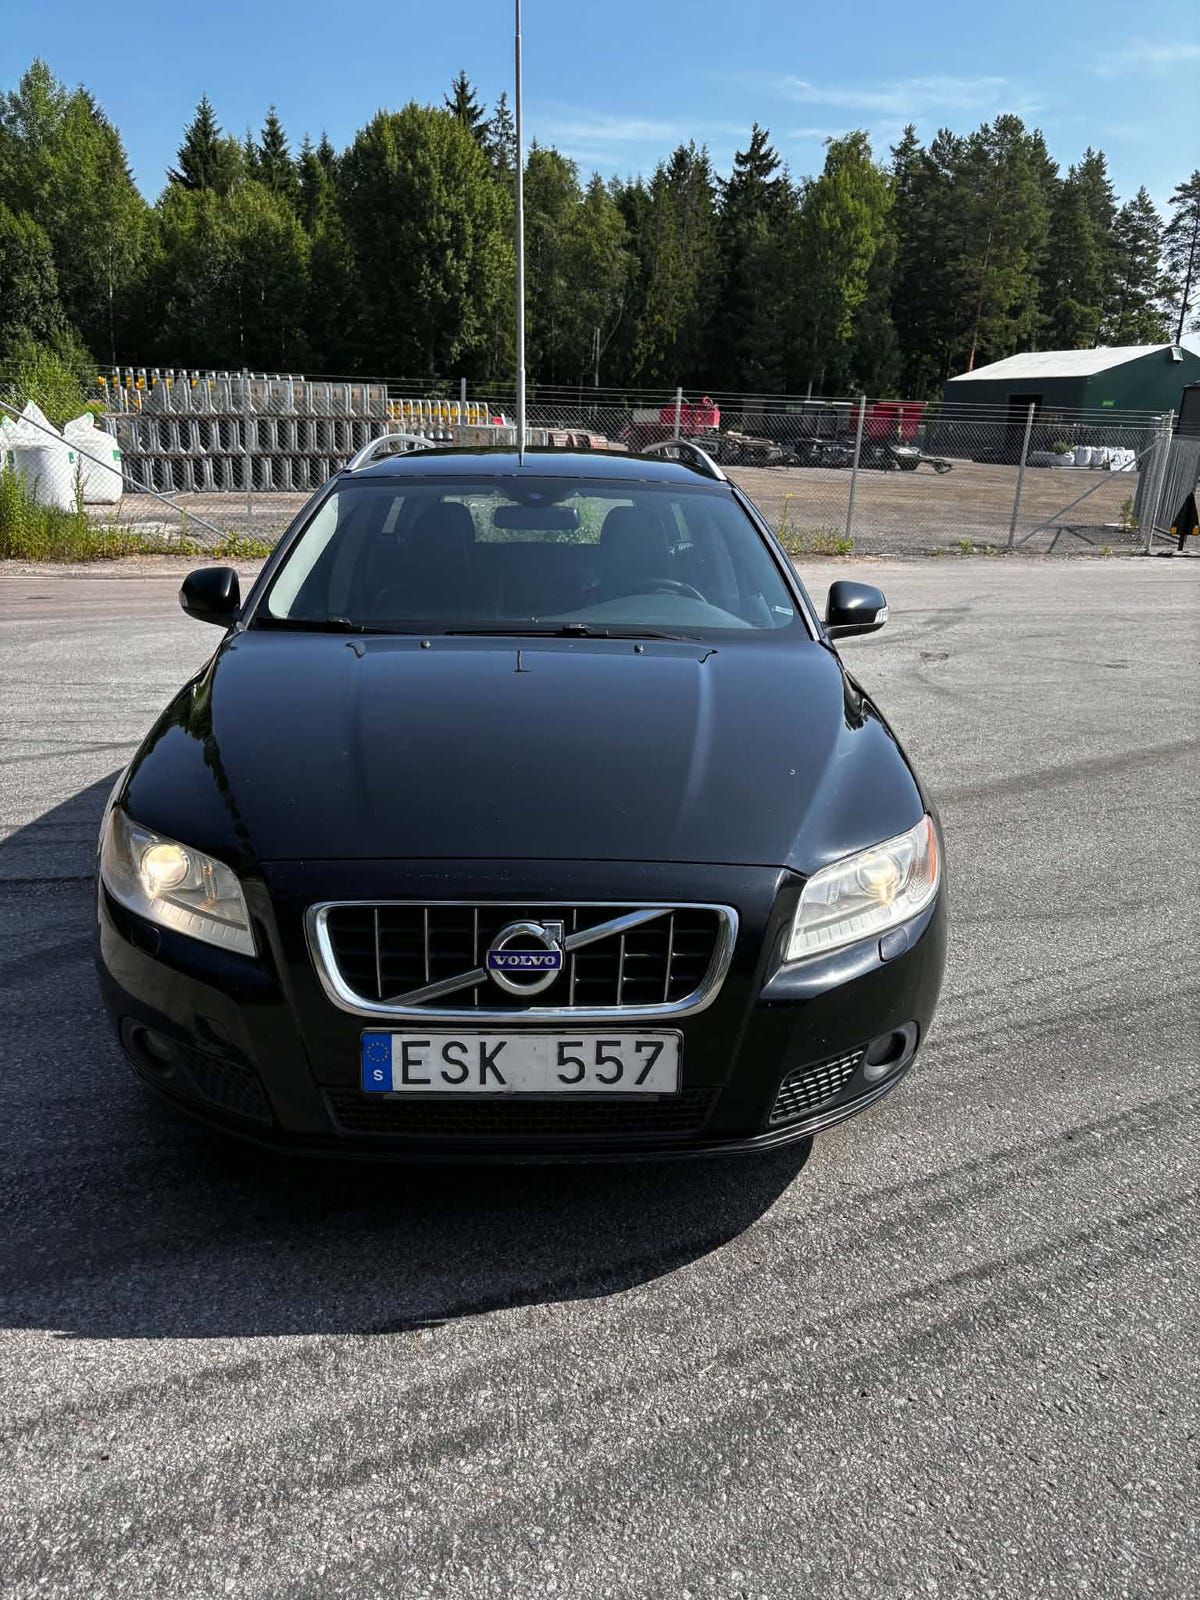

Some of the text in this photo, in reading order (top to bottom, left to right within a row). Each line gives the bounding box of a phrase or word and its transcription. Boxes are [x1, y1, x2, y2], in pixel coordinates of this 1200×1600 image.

[492, 955, 556, 966] VOLVO
[401, 1040, 664, 1085] ESK 557
[373, 1069, 384, 1081] S
